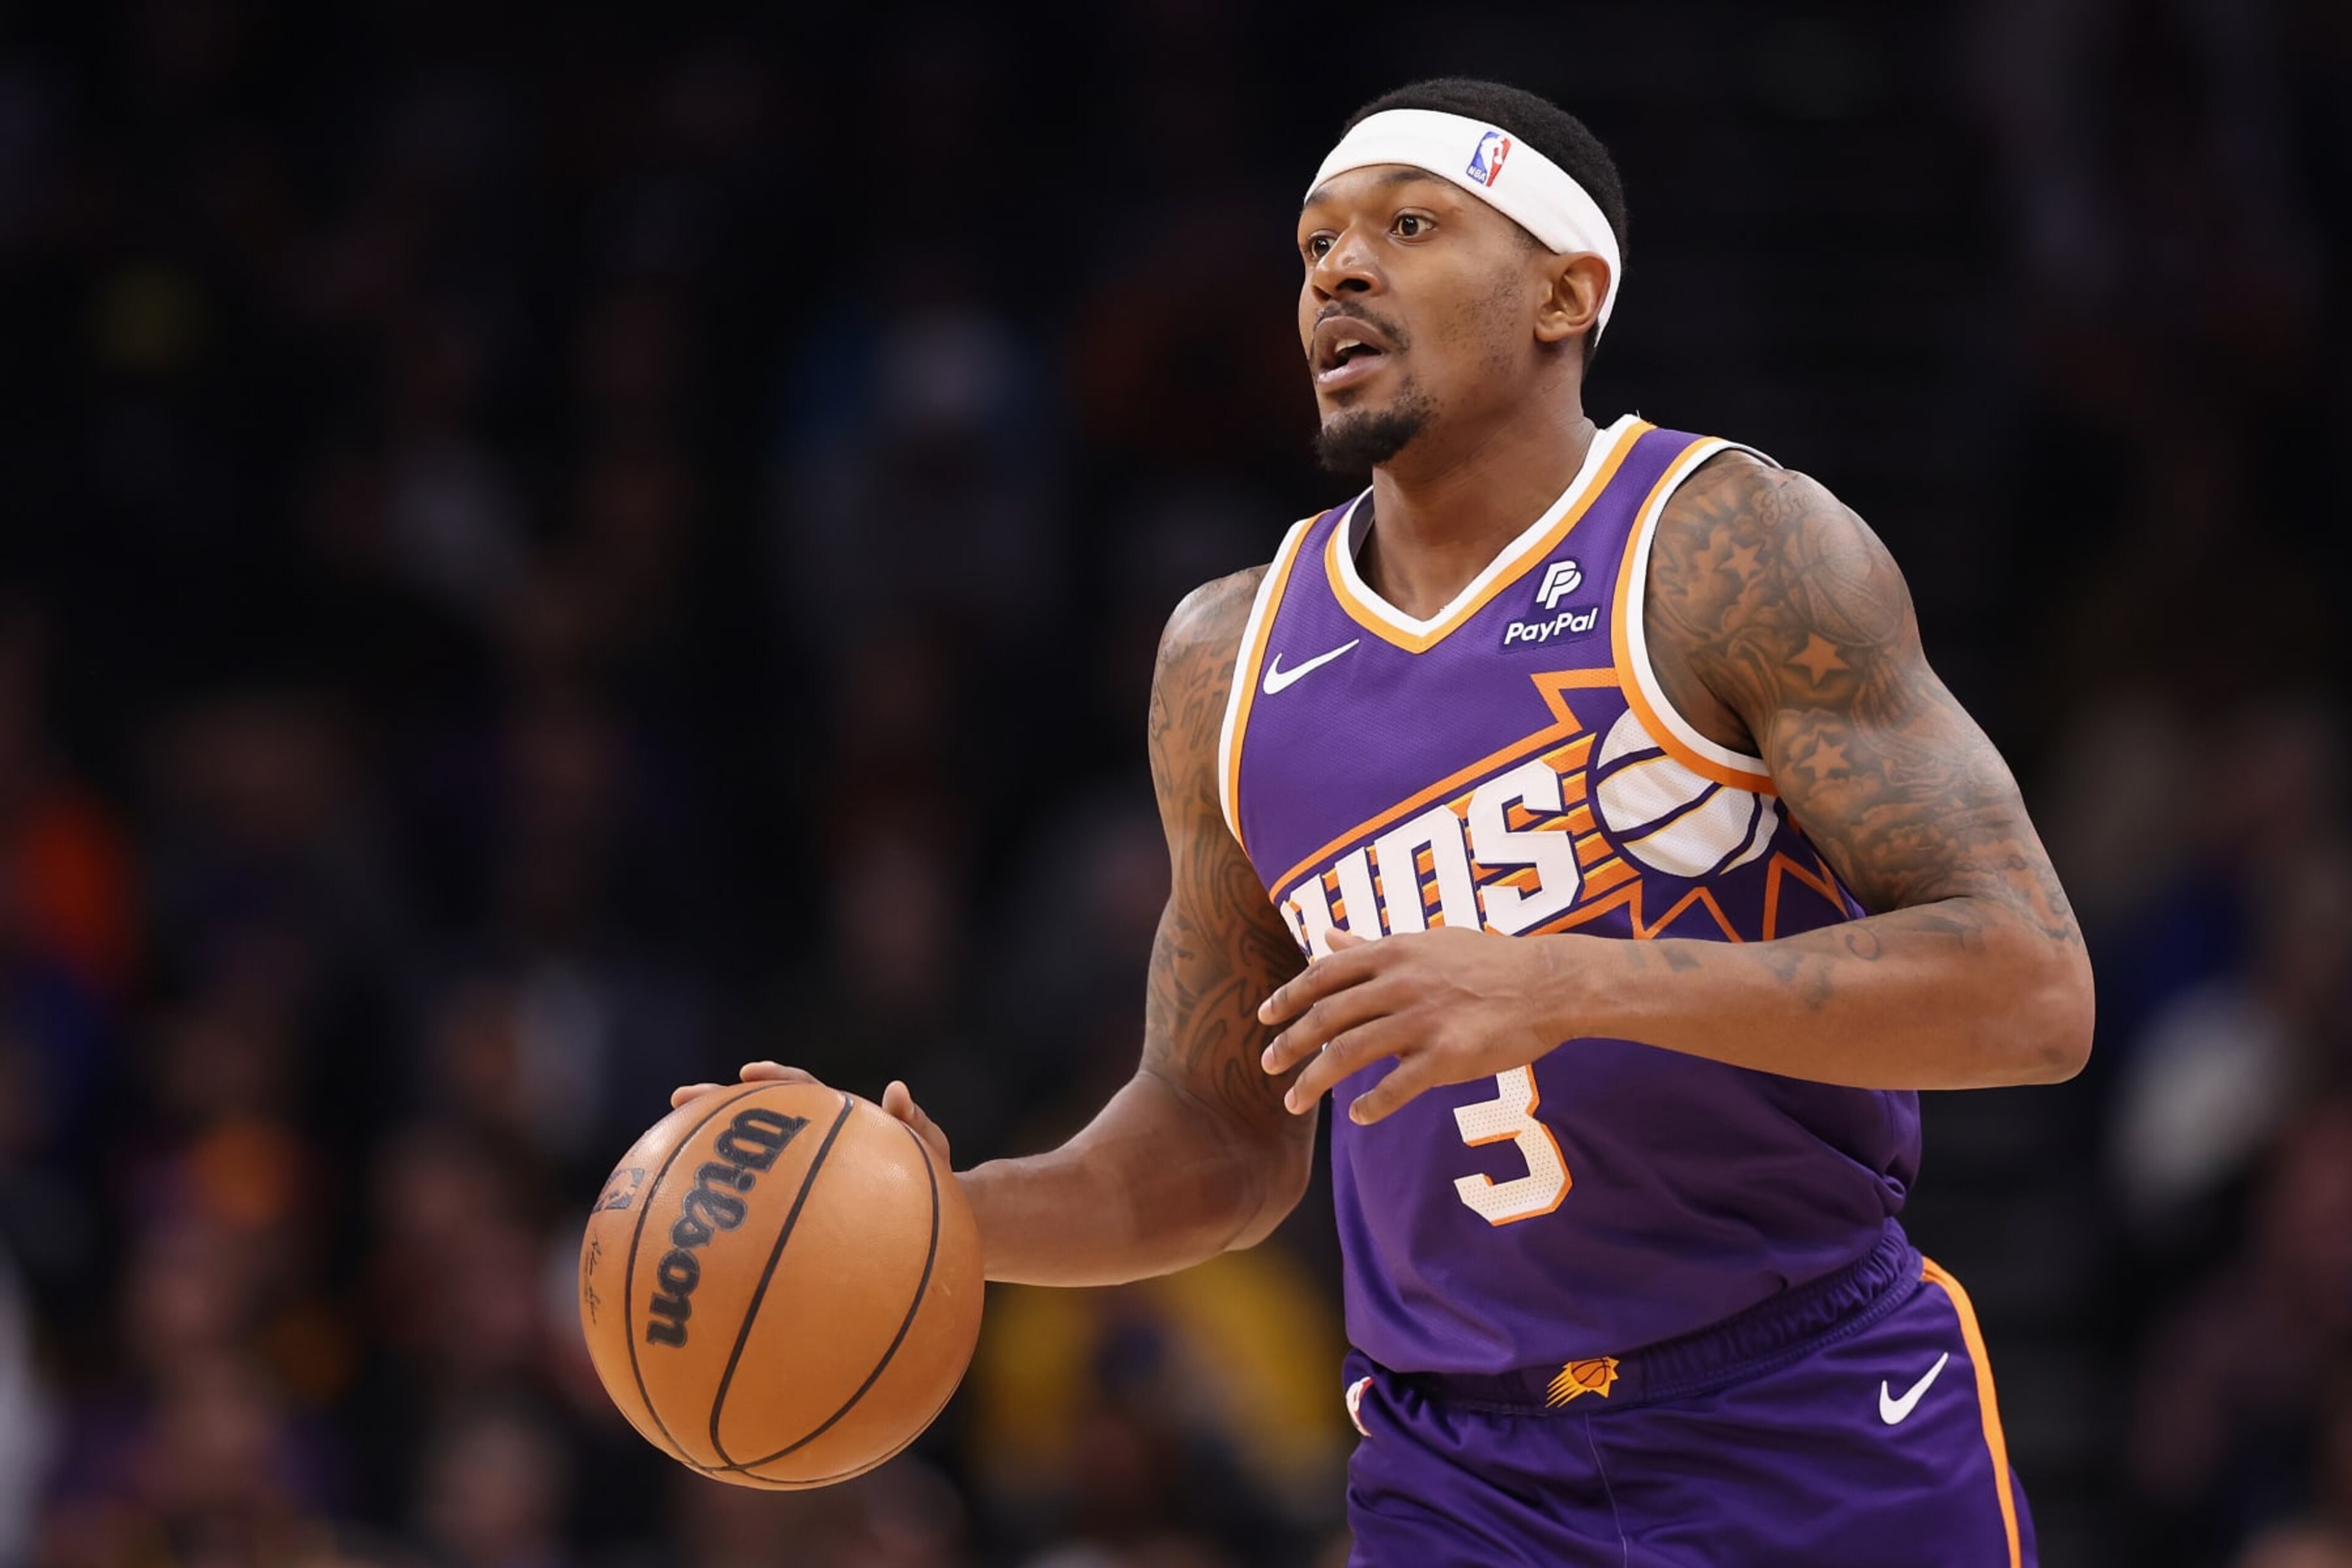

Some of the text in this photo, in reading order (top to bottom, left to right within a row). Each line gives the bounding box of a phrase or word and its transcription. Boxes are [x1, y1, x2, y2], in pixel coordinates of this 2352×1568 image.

[1468, 165, 1487, 181] NBA
[1504, 607, 1599, 645] PayPal
[1280, 759, 1581, 965] UNS
[1453, 1063, 1573, 1227] 3
[646, 1107, 812, 1349] Wilson
